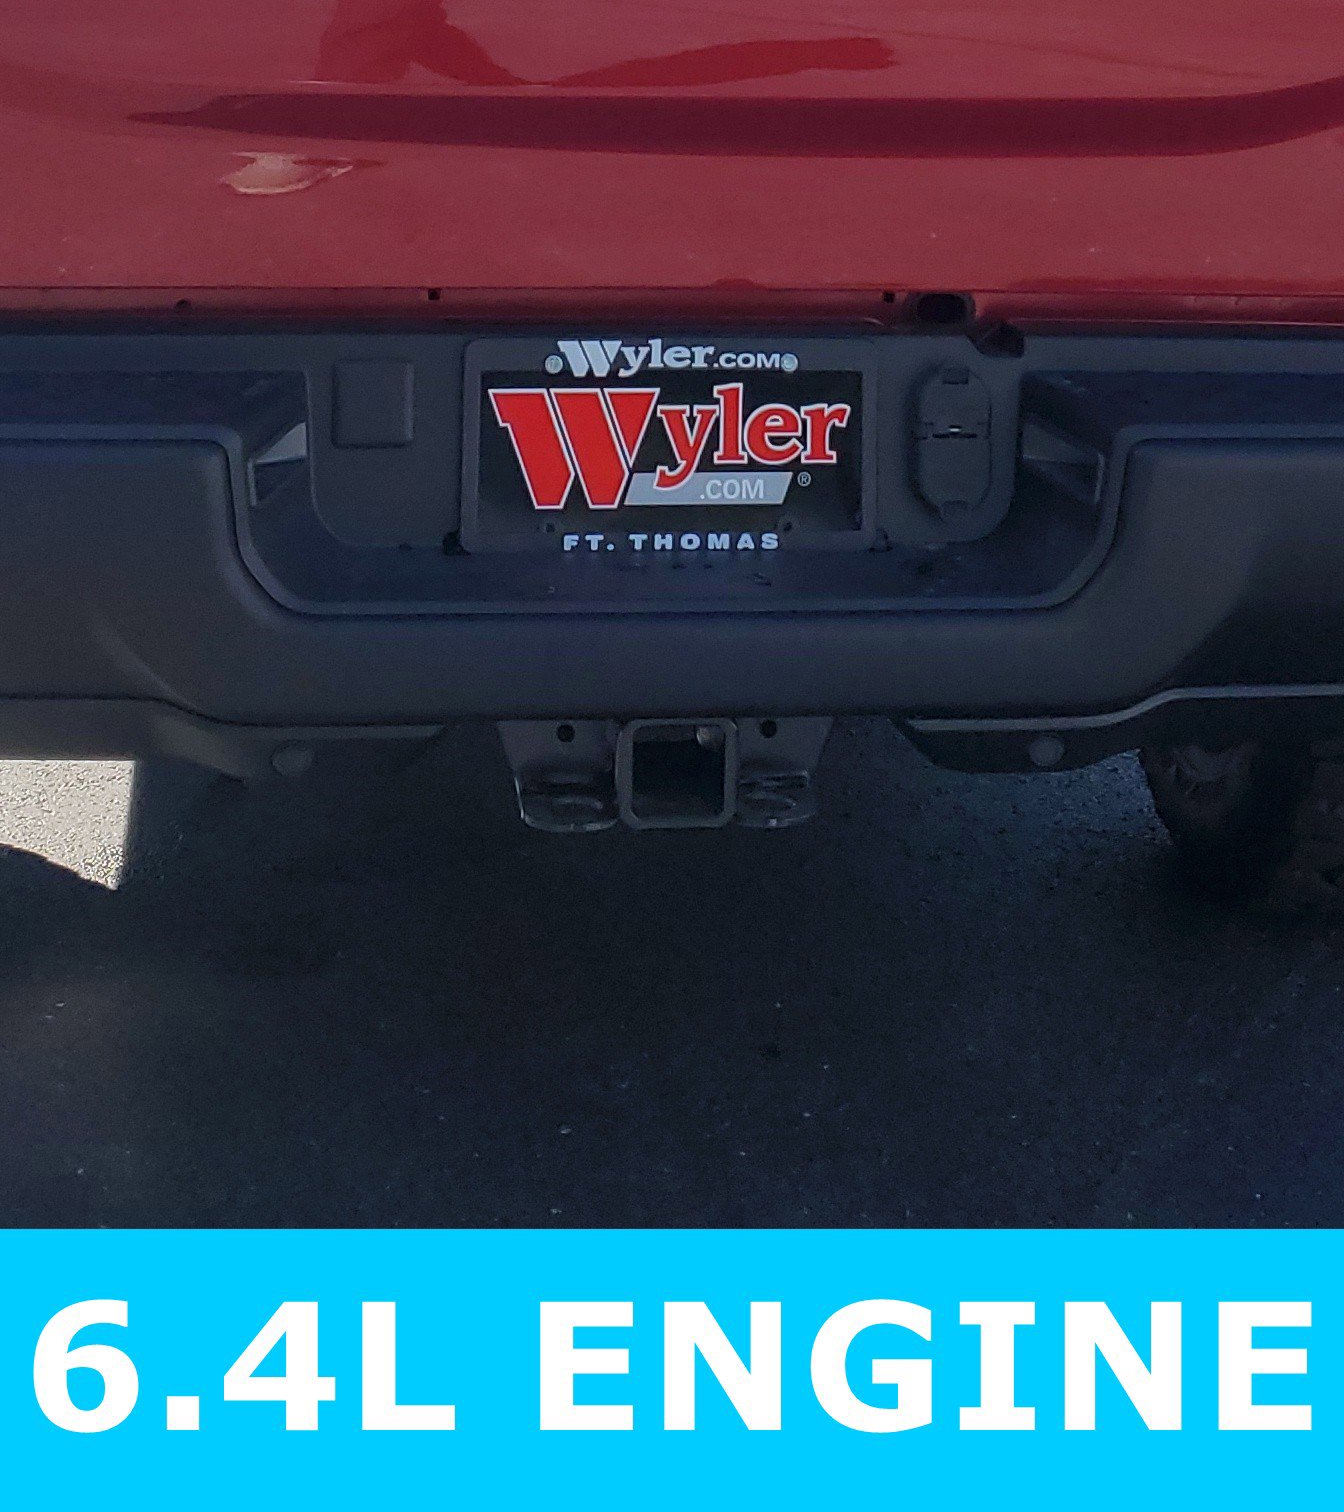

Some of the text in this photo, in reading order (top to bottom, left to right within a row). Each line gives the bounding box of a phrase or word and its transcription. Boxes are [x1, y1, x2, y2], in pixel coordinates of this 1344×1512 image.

[488, 382, 852, 510] Wyler
[563, 532, 780, 551] FT. THOMAS
